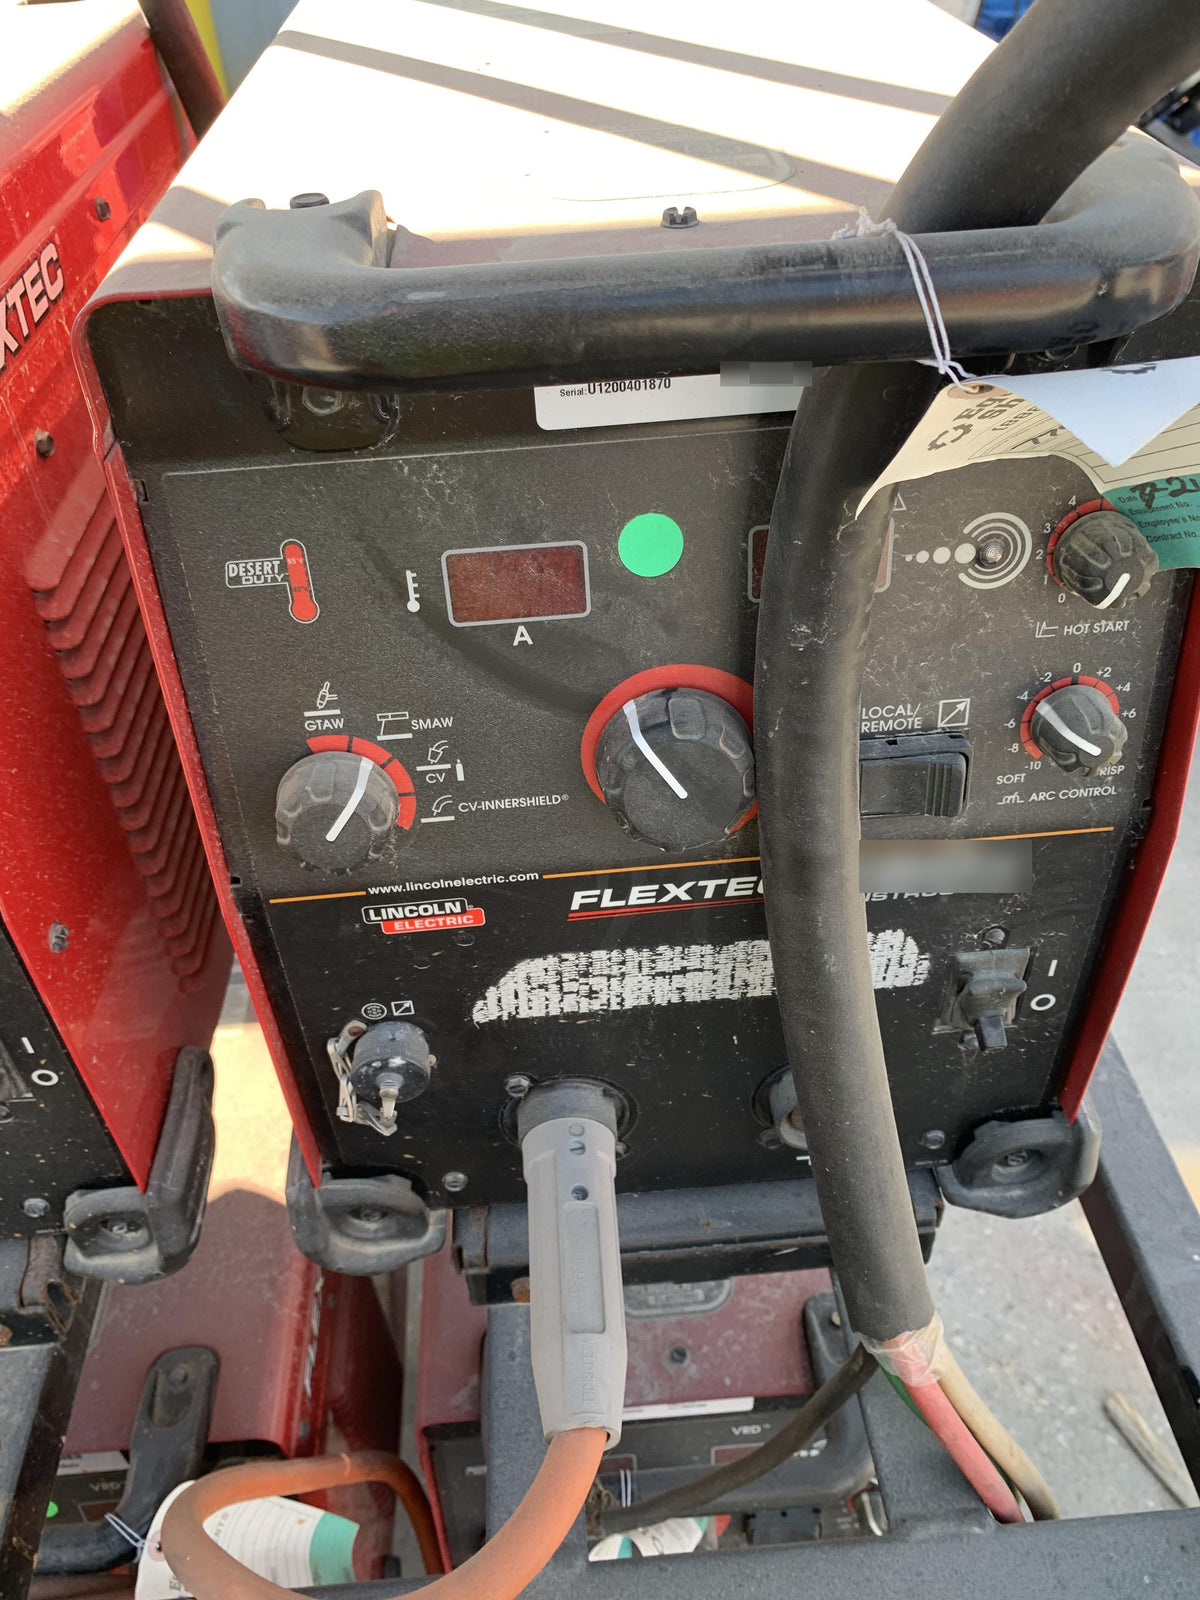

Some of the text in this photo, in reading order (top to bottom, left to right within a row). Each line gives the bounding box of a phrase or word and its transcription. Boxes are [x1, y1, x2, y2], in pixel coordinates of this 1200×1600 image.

[1068, 495, 1077, 506] 4
[1043, 523, 1051, 534] 3
[1145, 531, 1182, 543] Contract
[1035, 549, 1044, 560] 2
[228, 561, 280, 577] DESERT
[242, 573, 286, 585] DUTY
[1043, 574, 1049, 586] 1
[1057, 592, 1066, 603] 0
[1063, 620, 1130, 636] HOT START
[512, 625, 534, 646] A
[1072, 662, 1082, 674] 0
[1096, 667, 1112, 678] +2
[1115, 682, 1131, 693] +4
[862, 702, 922, 720] LOCAL/
[1121, 708, 1137, 719] +6
[304, 718, 345, 731] GTAW
[411, 716, 454, 731] SMAW
[861, 716, 923, 733] REMOTE
[1024, 761, 1041, 771] -10
[1098, 764, 1125, 776] RISP
[425, 772, 446, 784] CV
[996, 773, 1026, 785] SOFT
[1029, 785, 1117, 802] ARC CONTROL
[367, 872, 539, 895] www.lincolnelectric.com
[570, 875, 763, 911] FLEXTE
[368, 901, 462, 921] LINCOLN
[394, 914, 475, 931] ELECTRIC
